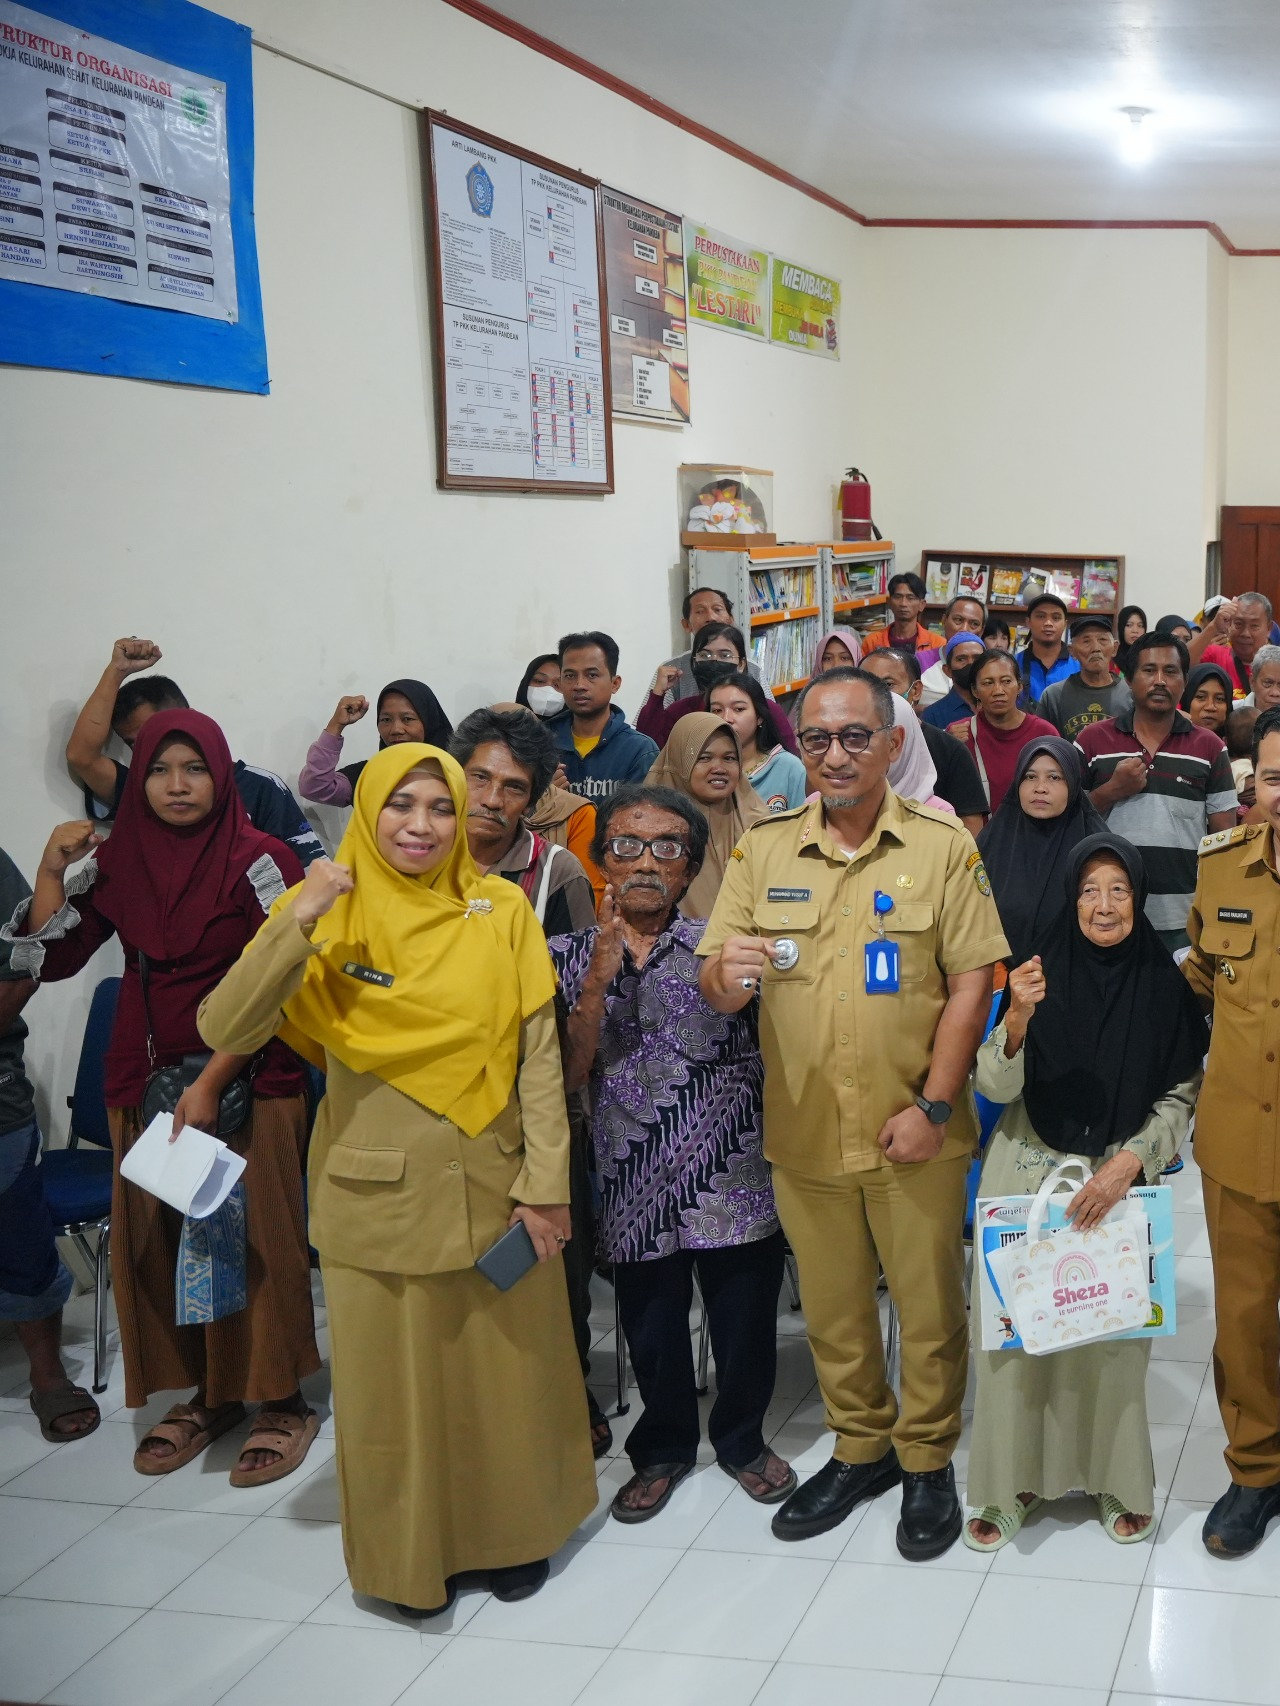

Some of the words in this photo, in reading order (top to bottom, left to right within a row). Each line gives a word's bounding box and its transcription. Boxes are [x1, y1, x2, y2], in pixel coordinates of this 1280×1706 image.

[18, 50, 66, 77] KELURAHAN
[66, 67, 90, 85] SEHAT
[91, 76, 133, 100] KELURAHAN
[134, 90, 165, 111] PANDEAN
[76, 51, 173, 98] ORGANISASI
[451, 139, 463, 151] ARTI
[463, 145, 487, 161] LAMBANG
[487, 154, 498, 164] PKK
[695, 235, 761, 274] PERPUSTAKAAN
[781, 265, 834, 303] MEMBACA
[691, 283, 761, 327] "LESTARI"
[462, 313, 485, 325] SUSUNAN
[485, 319, 510, 330] PENGURUS
[470, 324, 498, 337] KELURAHAN
[498, 330, 519, 341] PANDEAN
[363, 971, 383, 982] RINA
[1052, 1282, 1110, 1308] Sheza
[1095, 1298, 1109, 1308] one
